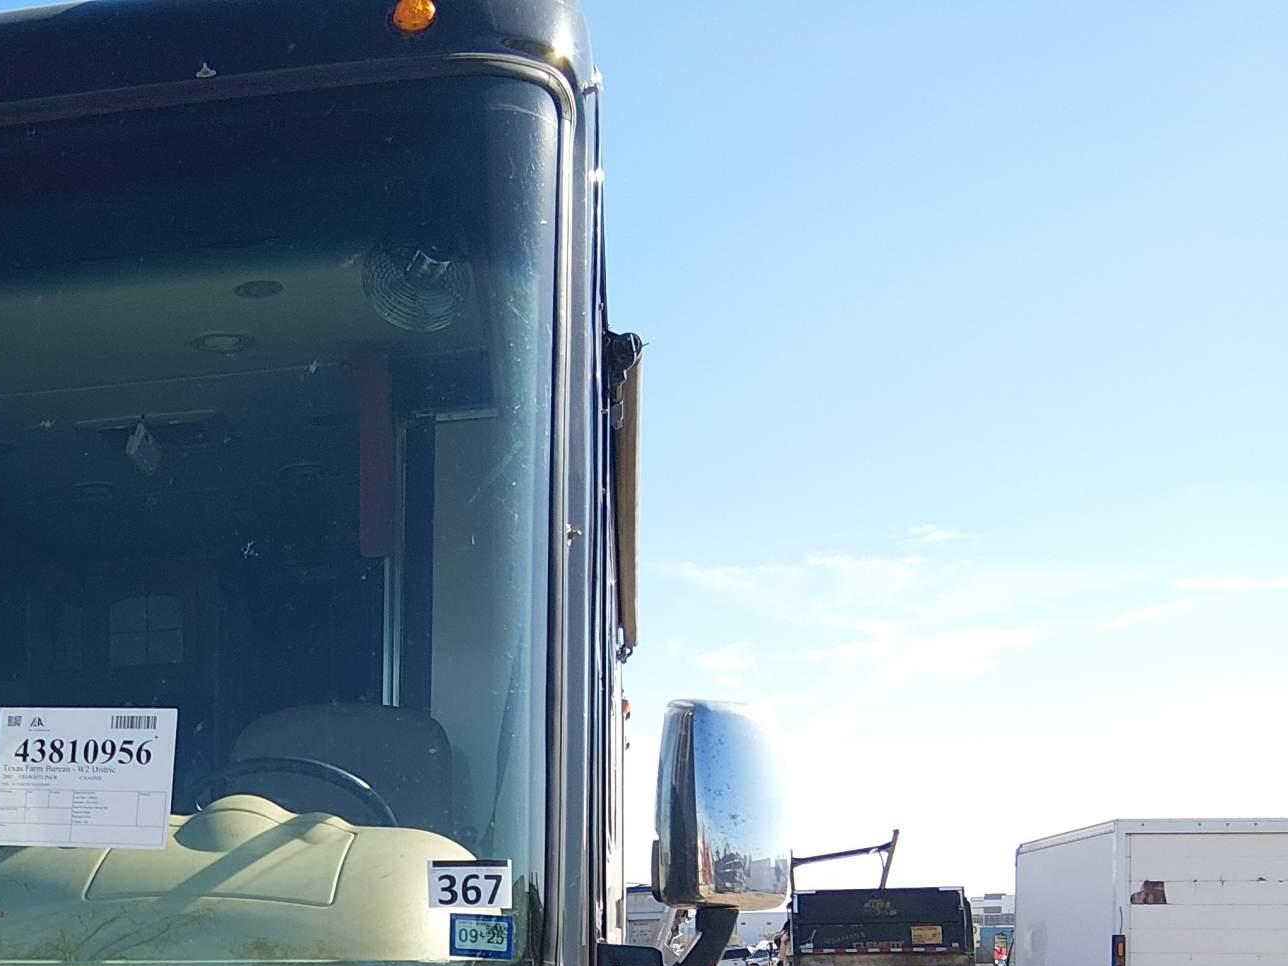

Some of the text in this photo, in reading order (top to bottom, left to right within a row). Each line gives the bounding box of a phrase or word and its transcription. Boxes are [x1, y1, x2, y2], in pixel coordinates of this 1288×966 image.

[14, 738, 153, 765] 43810956
[3, 765, 23, 773] Texas
[25, 765, 44, 773] Farm
[45, 765, 71, 773] Bureau
[438, 874, 502, 905] 367
